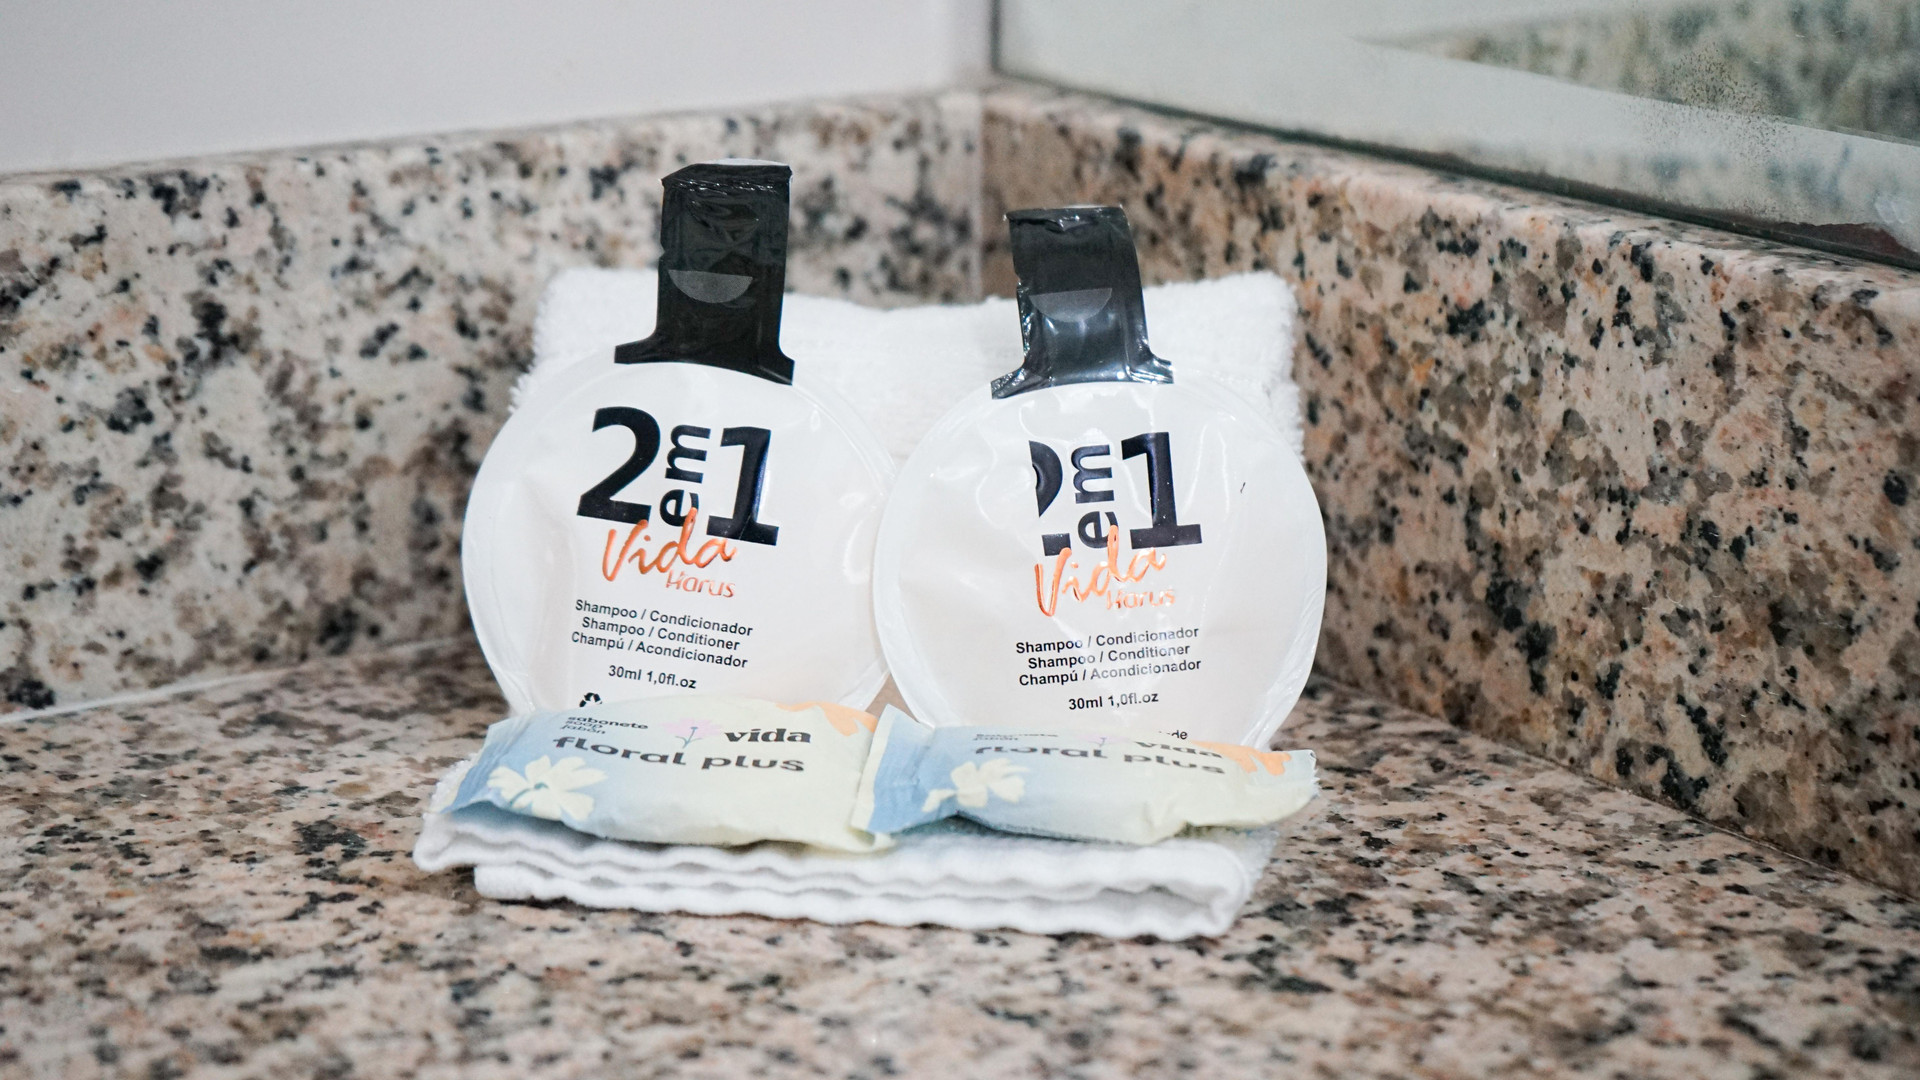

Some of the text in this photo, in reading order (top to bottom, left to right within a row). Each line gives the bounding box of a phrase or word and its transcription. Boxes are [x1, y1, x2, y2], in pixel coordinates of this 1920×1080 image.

[577, 406, 780, 546] 2 em 1
[1070, 444, 1119, 549] em
[1121, 432, 1203, 550] 1
[602, 508, 738, 582] Vida
[665, 569, 736, 598] Harus
[1034, 524, 1167, 617] Vida
[575, 599, 754, 636] Shampoo / Condicionador
[581, 616, 741, 651] Shampoo / Conditioner
[571, 631, 749, 669] Champú / Acondicionador
[1015, 639, 1083, 654] Shampoo
[1095, 626, 1199, 647] Condicionador
[1018, 670, 1079, 687] Champú
[1089, 659, 1202, 681] Acondicionador
[1027, 654, 1096, 670] Shampoo
[1107, 644, 1191, 662] Conditioner
[608, 665, 697, 690] 30ml 1,0fl.oz
[1067, 691, 1160, 711] 30ml 1,0fl.oz
[568, 716, 649, 730] sabonete
[724, 728, 811, 743] vida
[553, 736, 805, 772] floral plus
